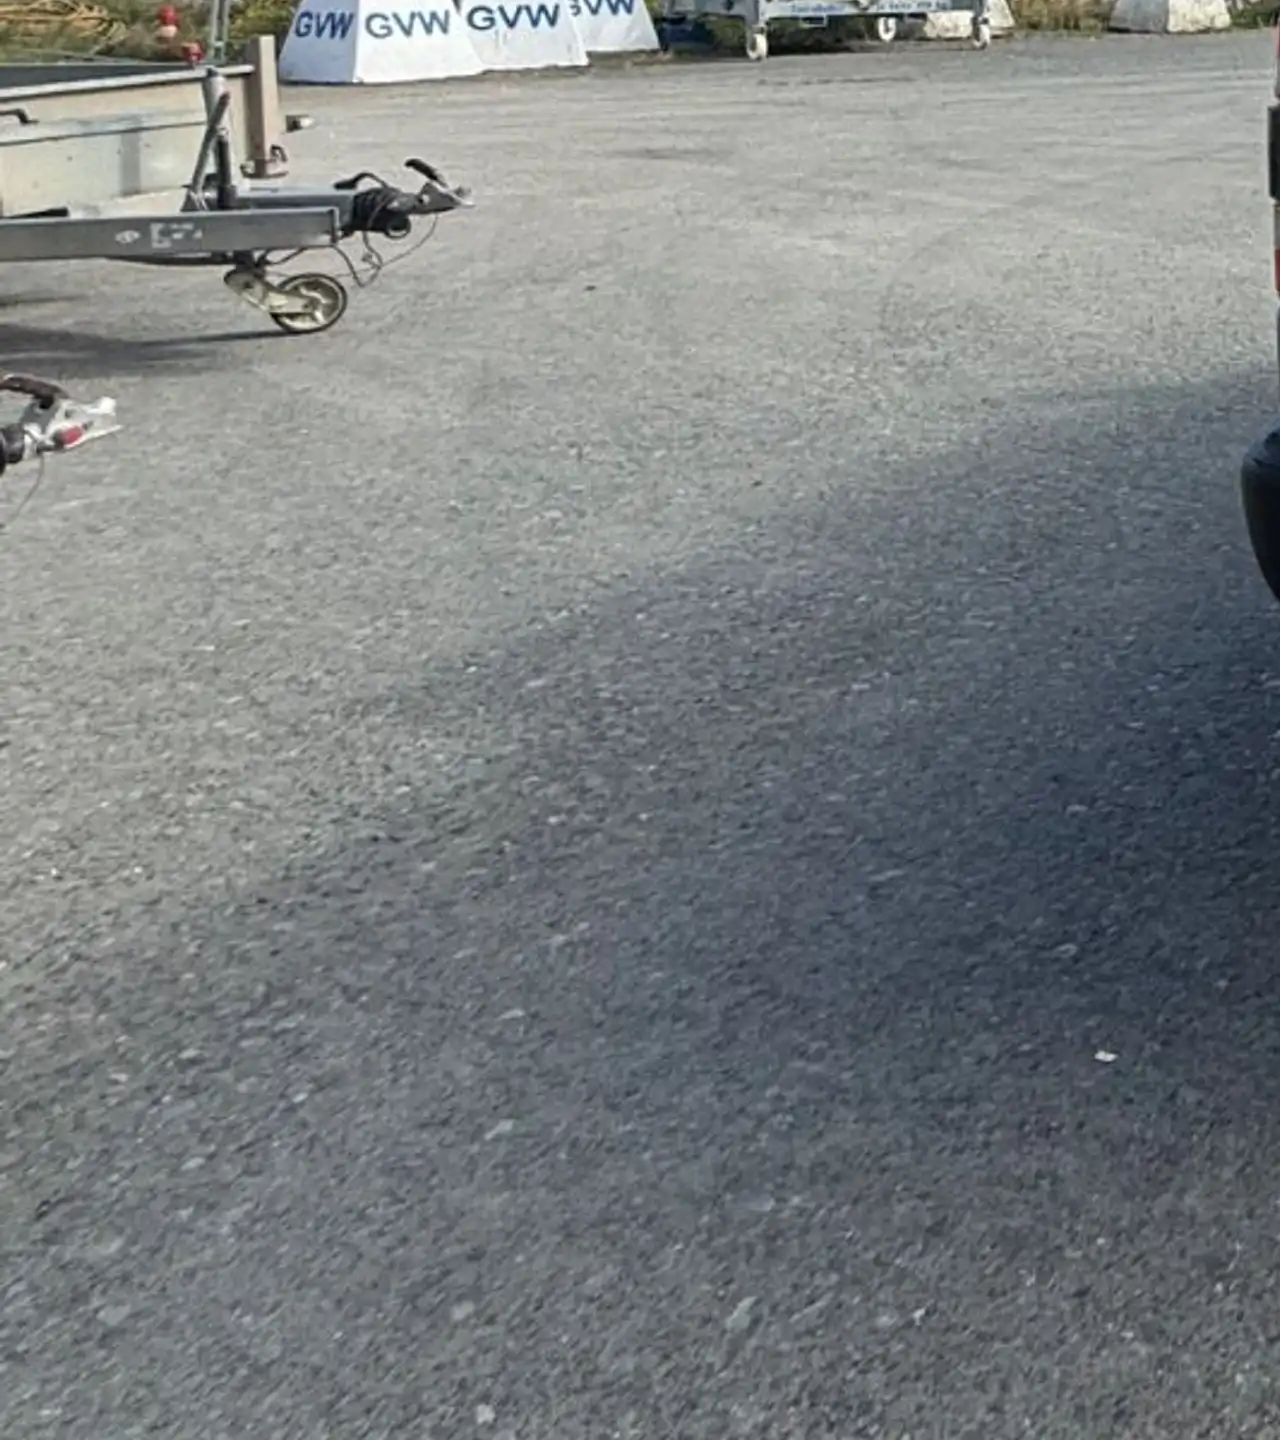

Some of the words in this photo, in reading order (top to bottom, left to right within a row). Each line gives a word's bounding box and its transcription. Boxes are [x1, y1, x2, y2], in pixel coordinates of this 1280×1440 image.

[293, 10, 355, 39] GVW
[364, 9, 452, 39] GVW
[466, 3, 561, 31] GVW
